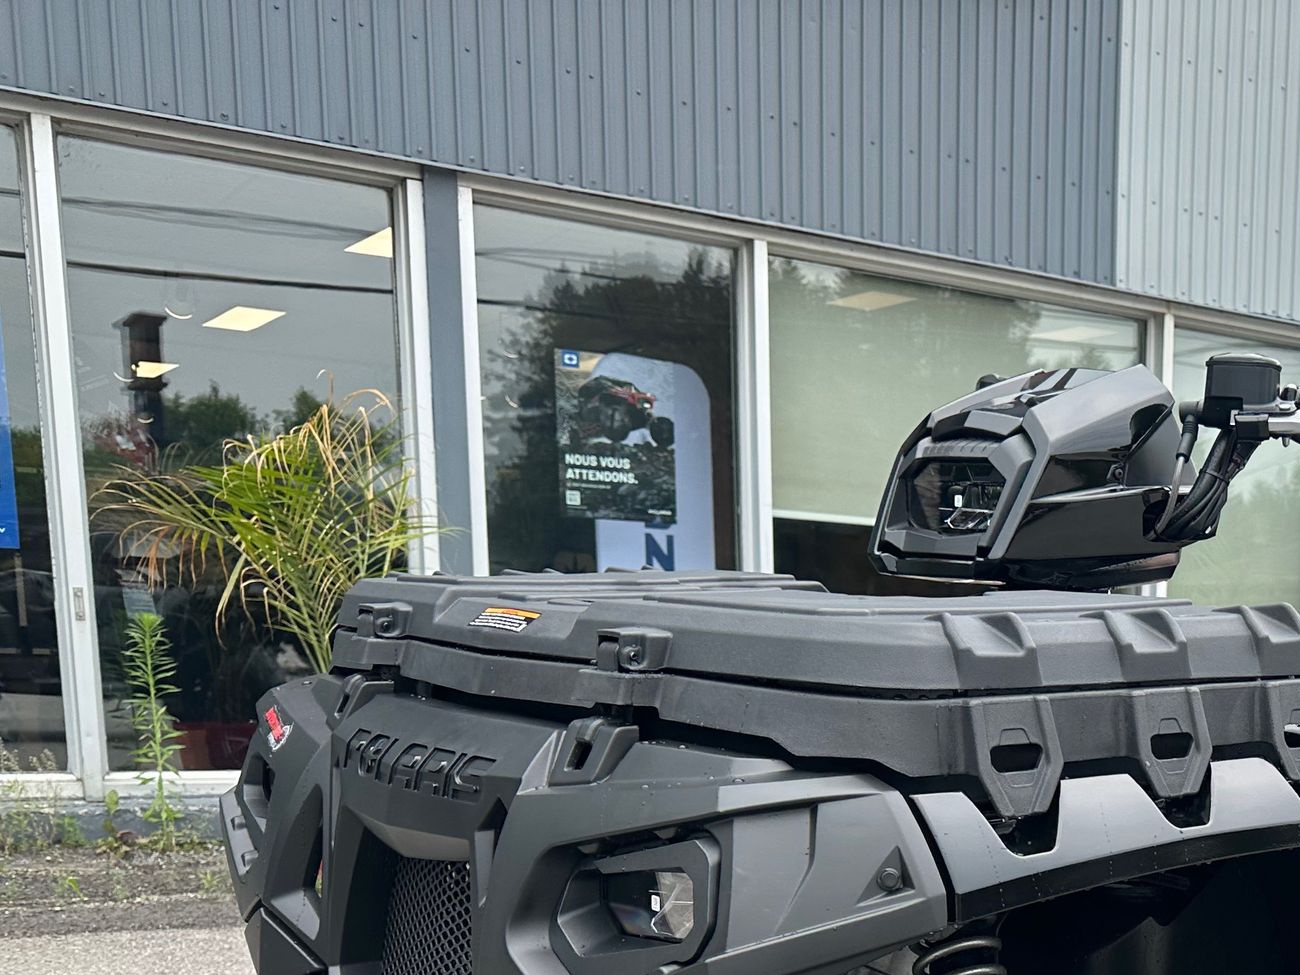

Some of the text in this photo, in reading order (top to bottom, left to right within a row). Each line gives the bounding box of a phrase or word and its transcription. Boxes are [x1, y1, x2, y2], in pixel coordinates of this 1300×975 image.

[565, 453, 631, 470] NOUS VOUS
[566, 468, 639, 484] ATTENDONS.
[343, 728, 497, 804] POLARIS
